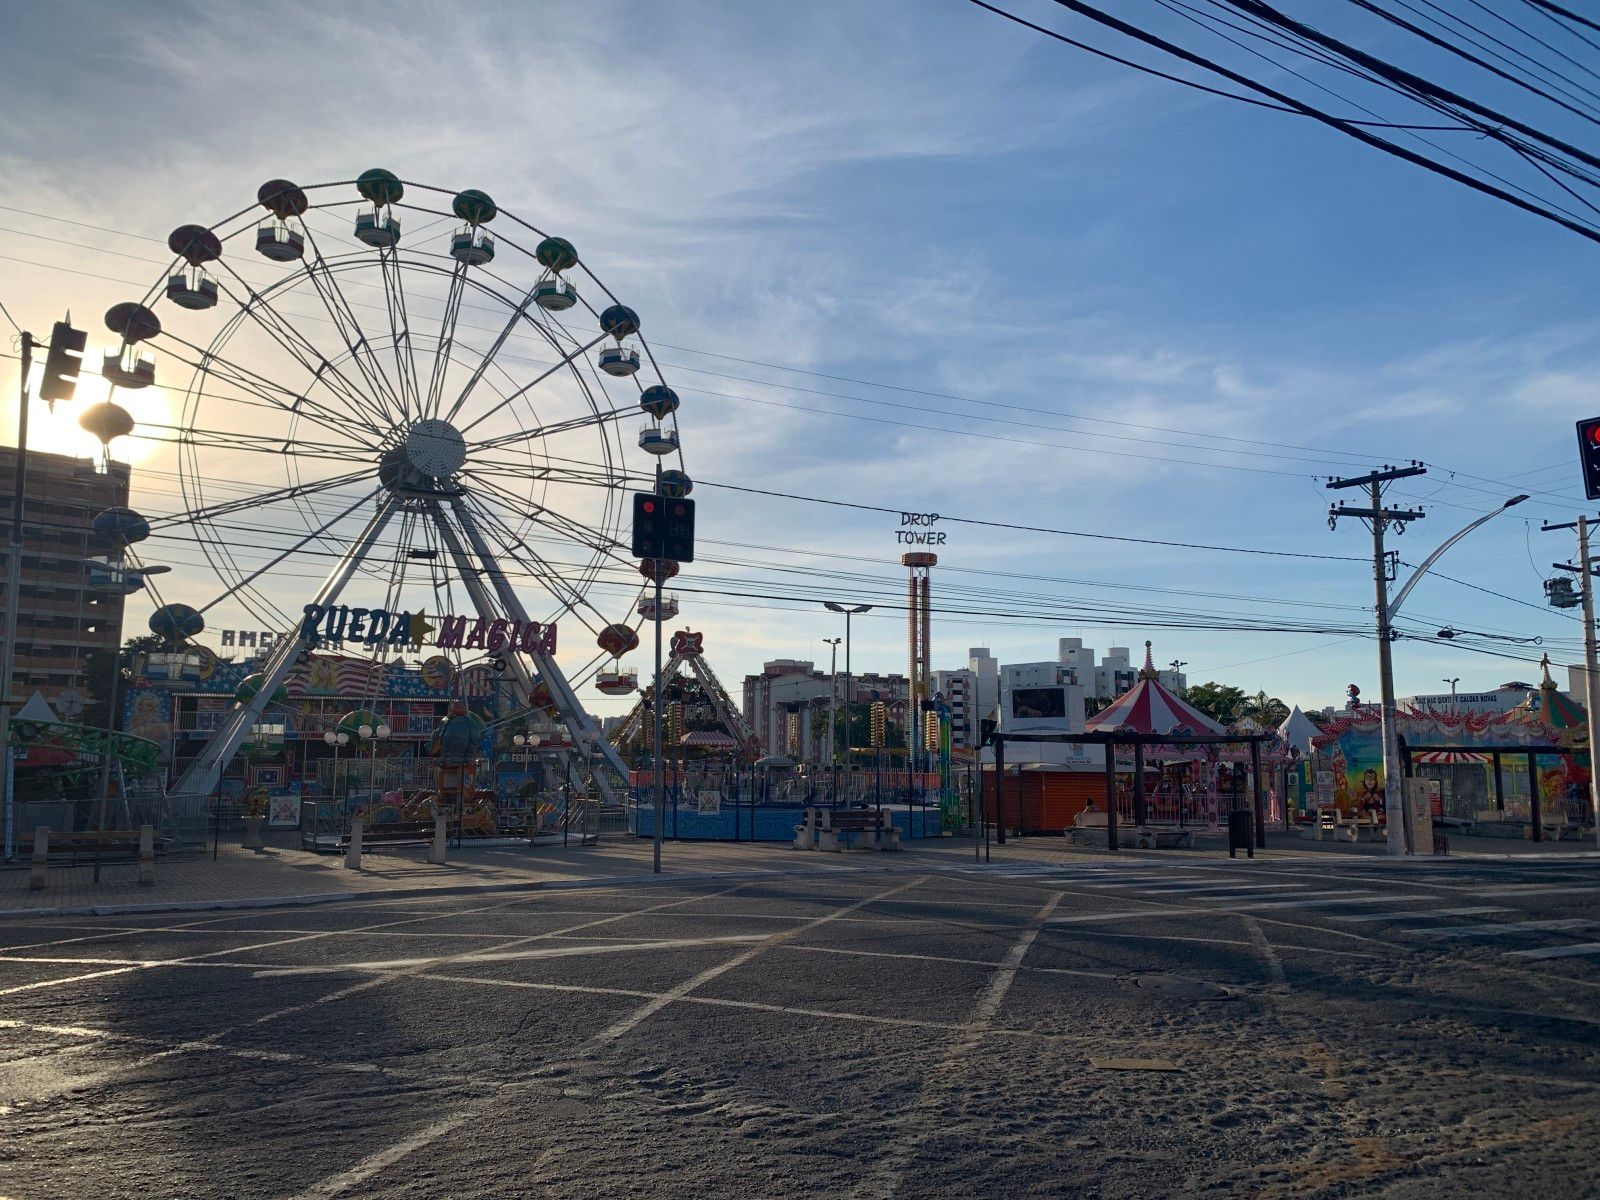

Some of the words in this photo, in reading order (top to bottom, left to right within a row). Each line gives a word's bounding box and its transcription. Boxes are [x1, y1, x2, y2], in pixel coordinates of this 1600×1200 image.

[901, 512, 940, 526] DROP
[895, 530, 947, 545] TOWER
[301, 603, 411, 646] RUEDA
[436, 614, 557, 656] MAGICA
[1460, 695, 1479, 703] CALDAS
[1480, 694, 1497, 703] NOVAS
